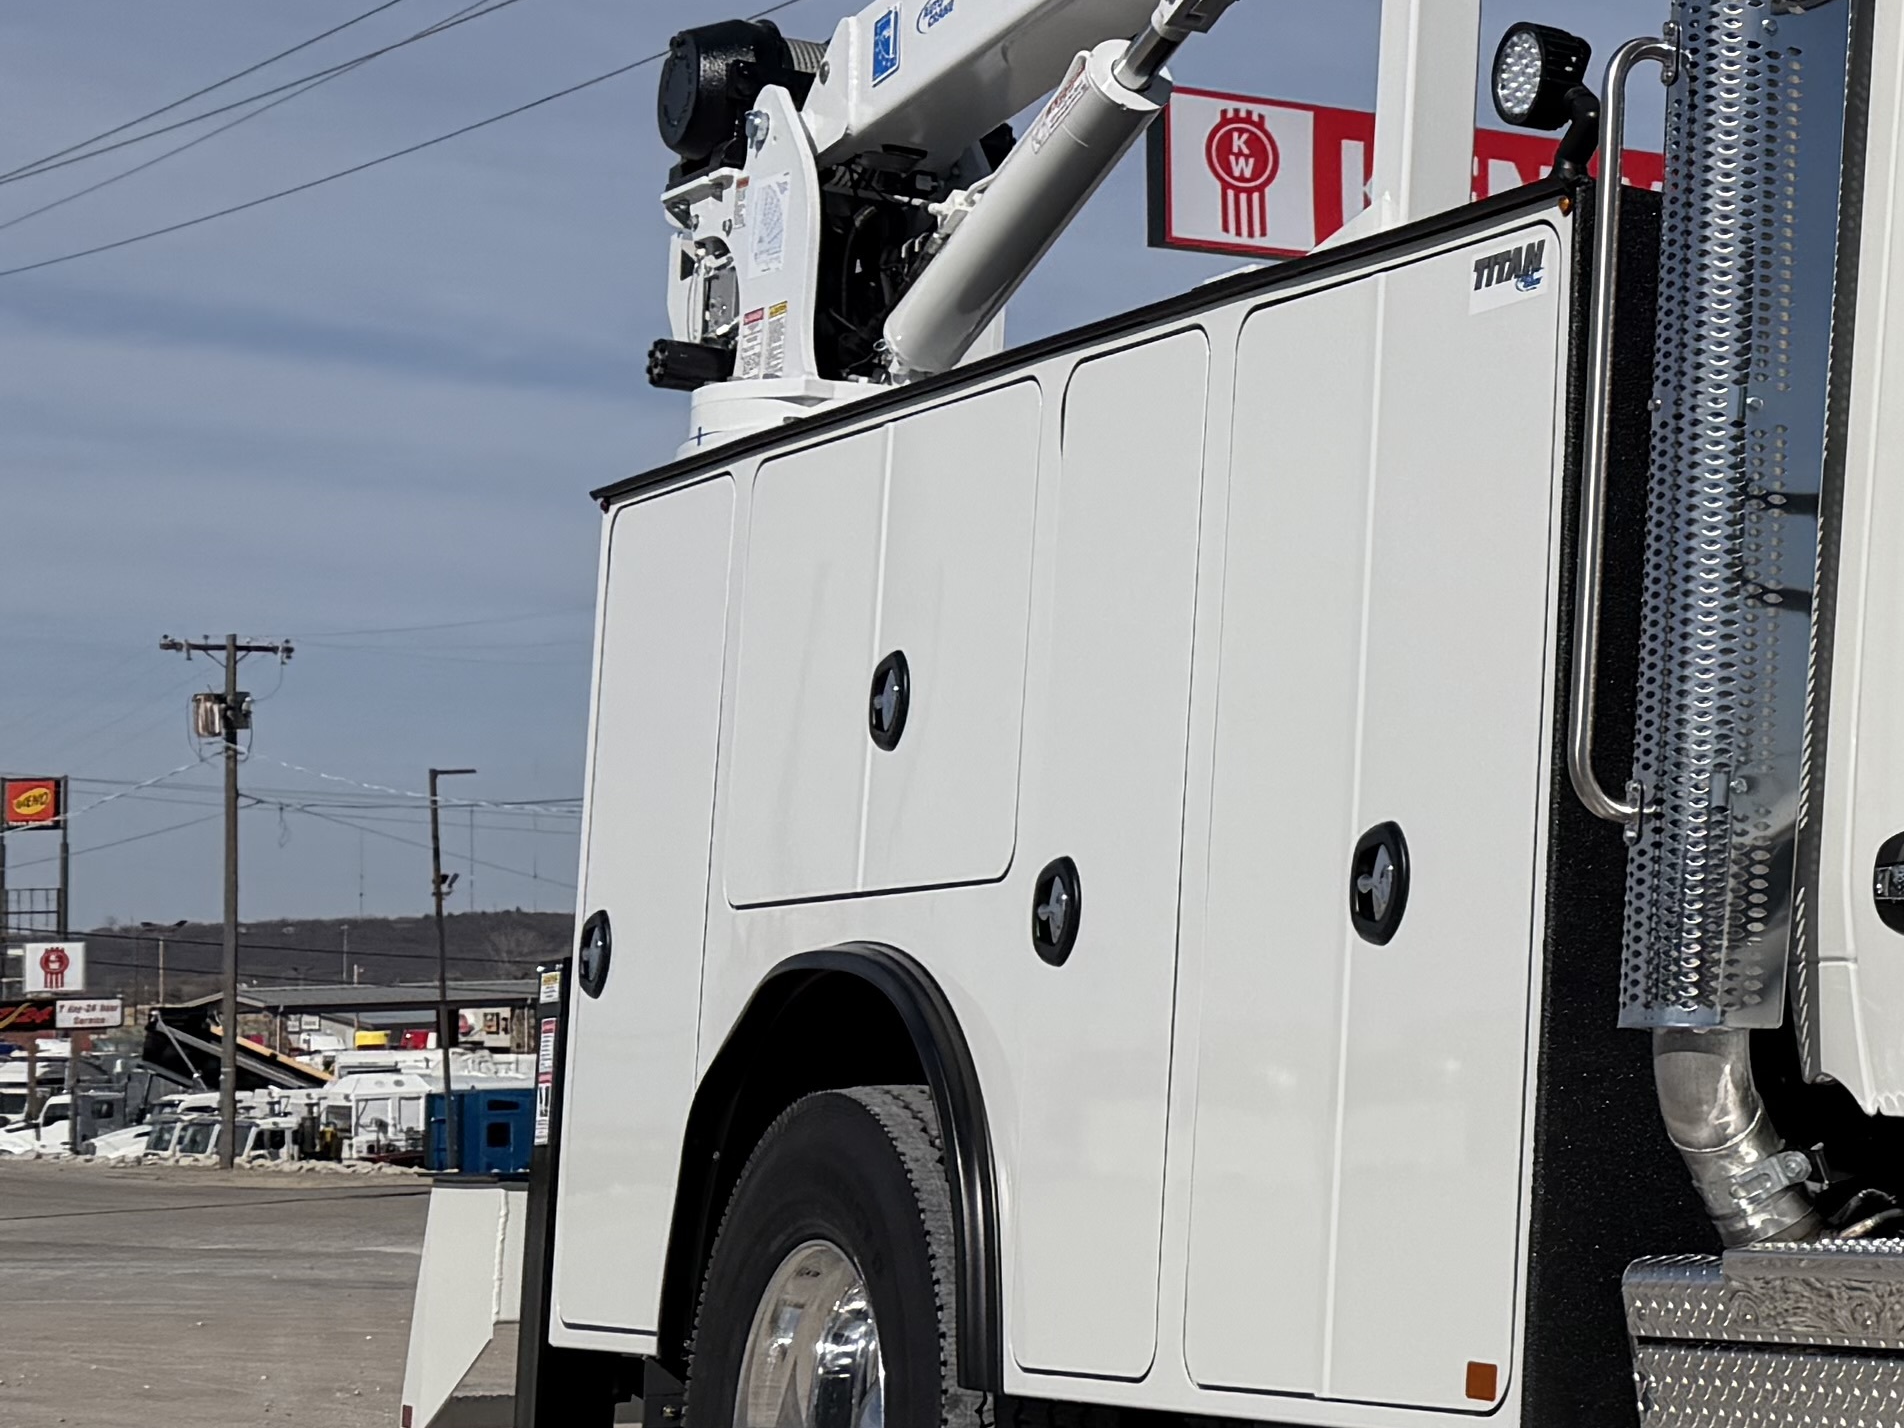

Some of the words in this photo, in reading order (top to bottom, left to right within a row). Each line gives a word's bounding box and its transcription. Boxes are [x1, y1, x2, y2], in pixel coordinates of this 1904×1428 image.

[1231, 131, 1251, 155] K
[1228, 154, 1255, 179] W
[1473, 239, 1546, 291] TITAN
